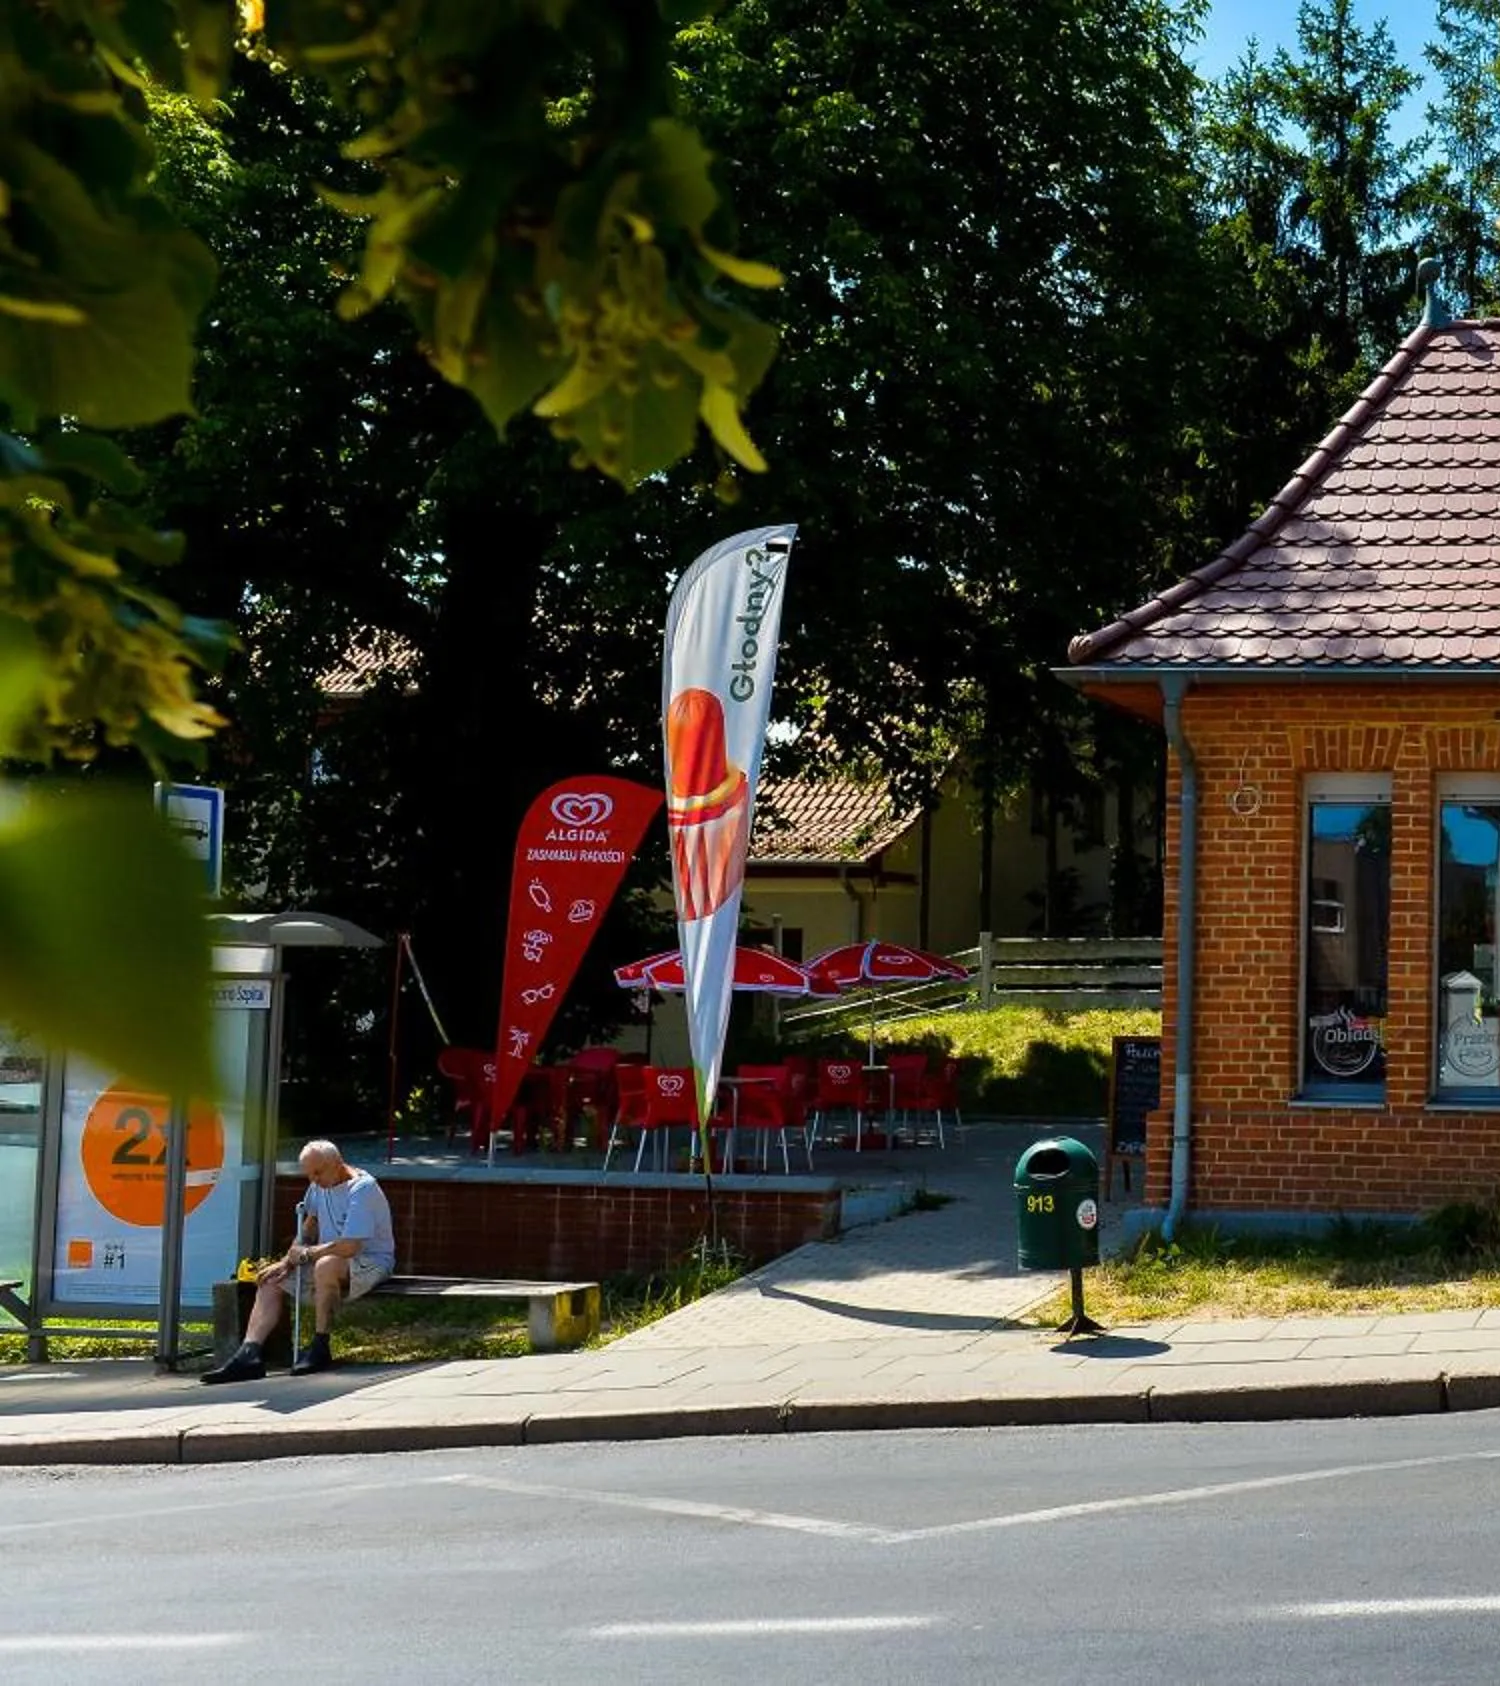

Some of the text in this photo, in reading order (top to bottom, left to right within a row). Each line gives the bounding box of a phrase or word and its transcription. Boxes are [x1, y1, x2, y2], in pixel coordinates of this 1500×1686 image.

[545, 828, 608, 844] ALGIDA
[1027, 1194, 1055, 1213] 913
[103, 1252, 126, 1269] #1
